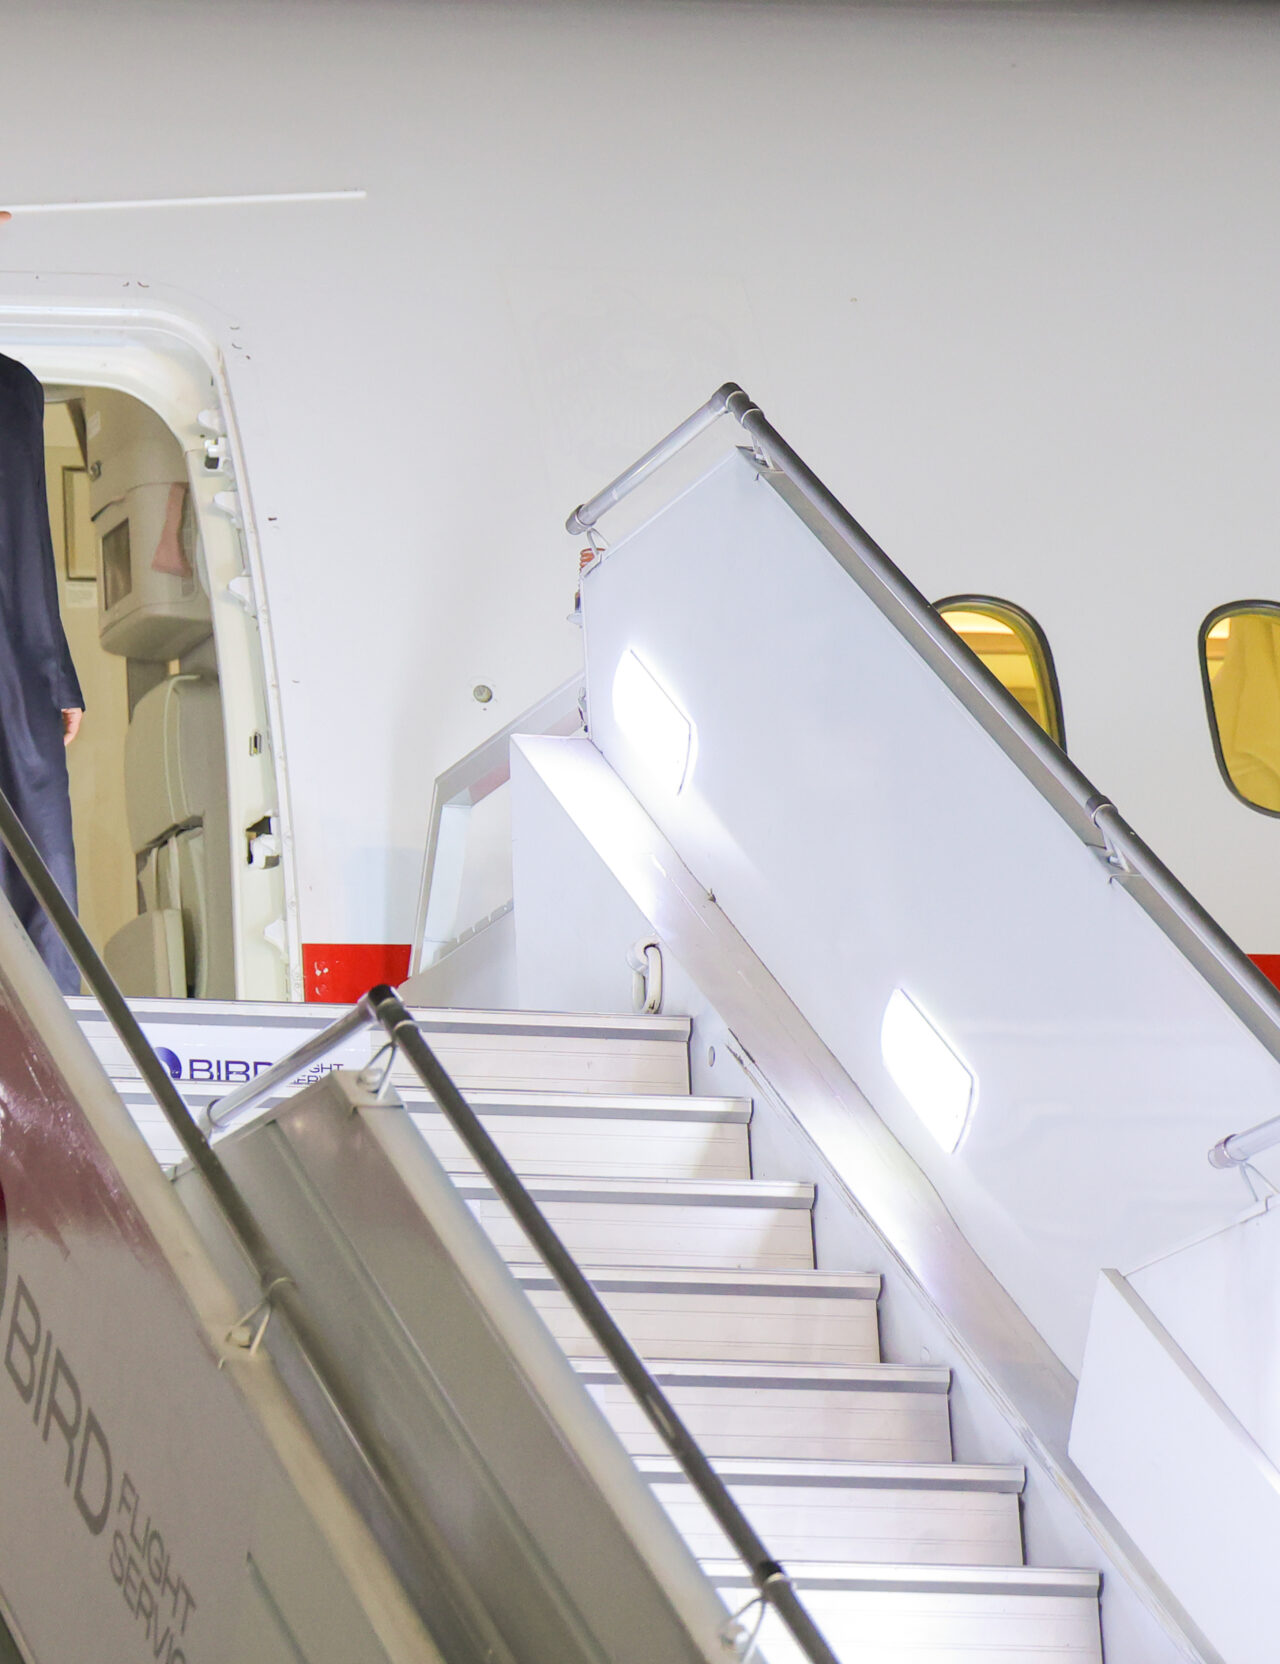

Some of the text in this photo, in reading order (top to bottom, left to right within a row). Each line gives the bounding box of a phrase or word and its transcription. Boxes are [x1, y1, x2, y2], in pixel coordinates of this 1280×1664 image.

[308, 1063, 345, 1073] GHT
[4, 1274, 113, 1537] BIRD
[110, 1529, 187, 1664] SERVI
[118, 1472, 197, 1637] FLIGHT
